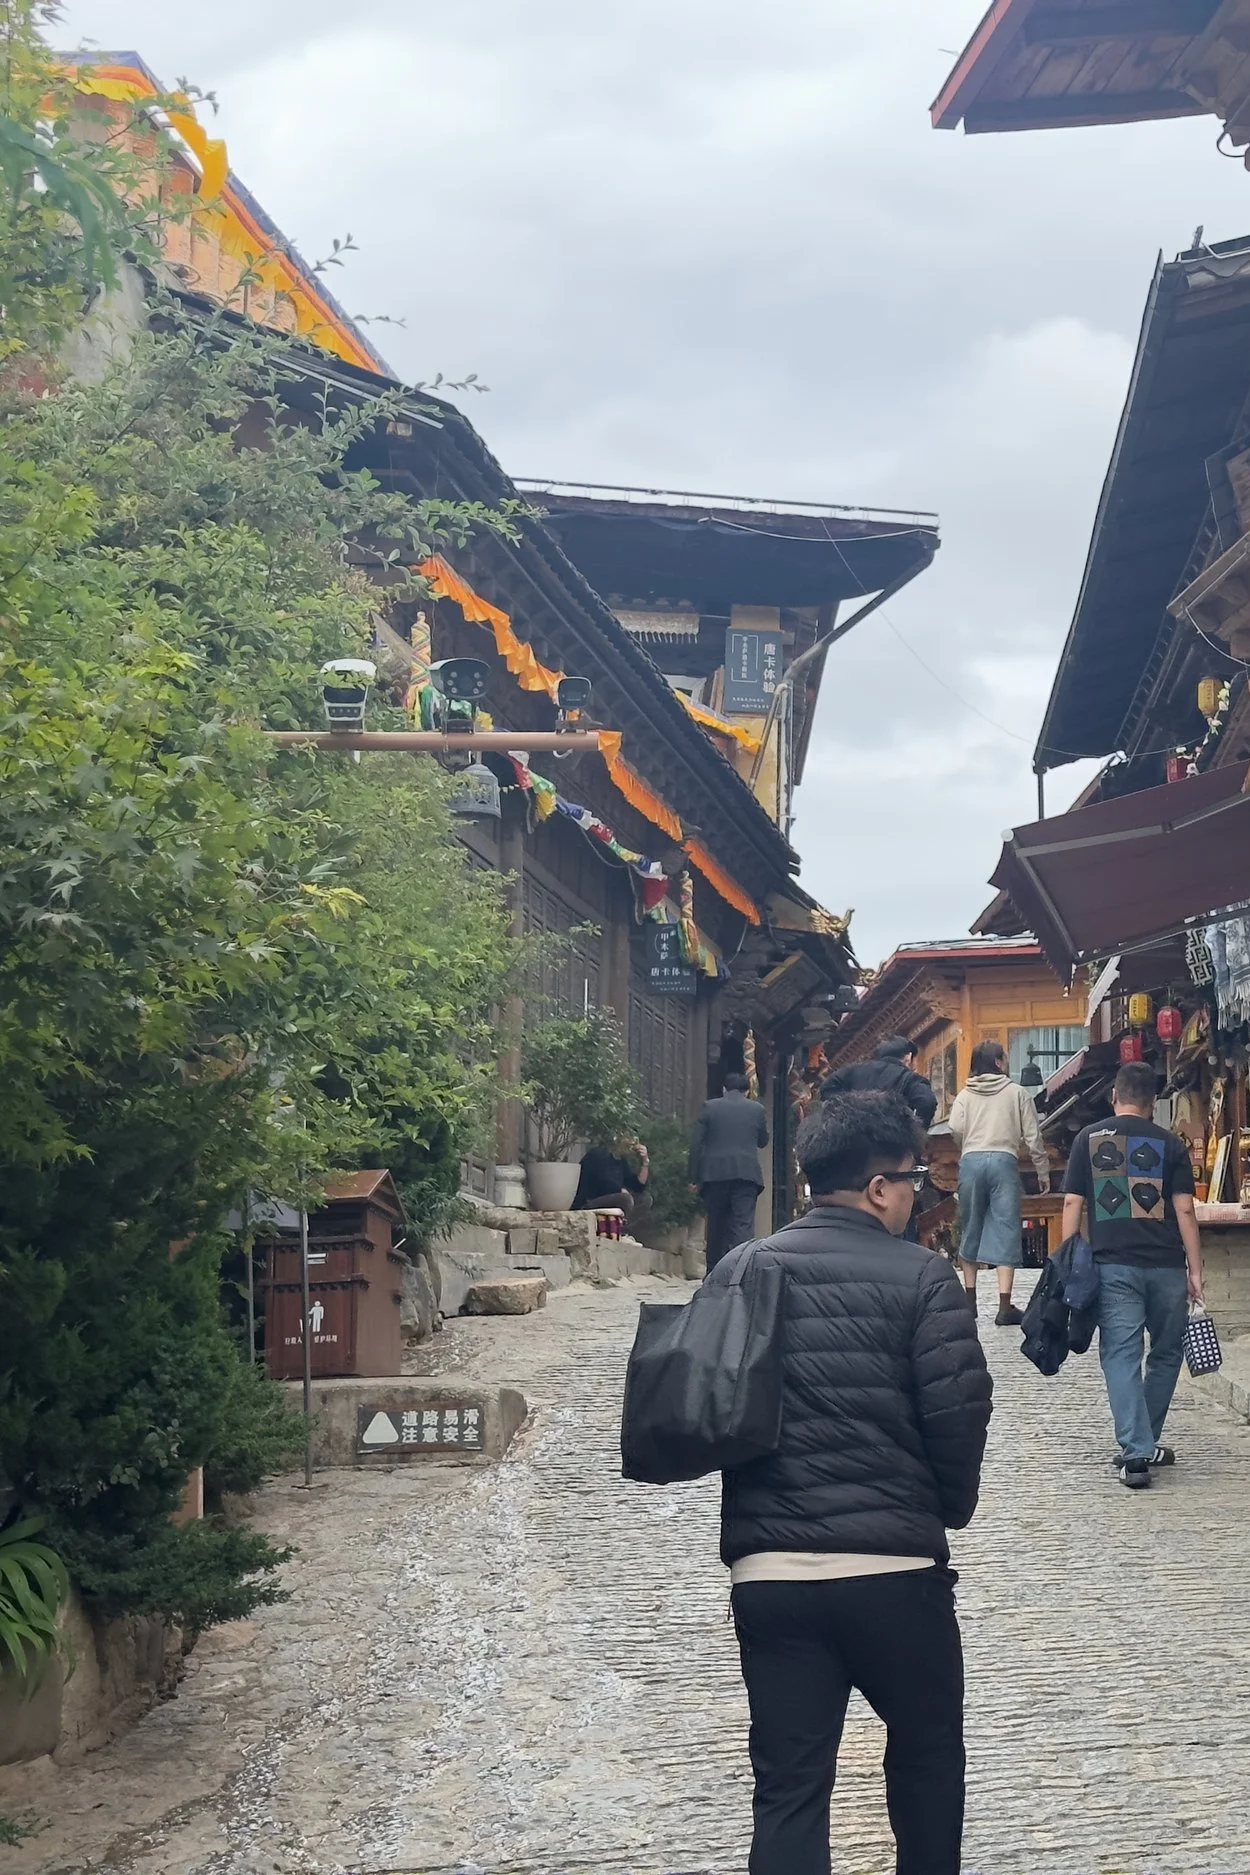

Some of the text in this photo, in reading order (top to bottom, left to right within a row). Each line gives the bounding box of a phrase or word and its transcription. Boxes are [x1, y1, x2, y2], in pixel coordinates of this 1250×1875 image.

[763, 643, 776, 693] 唐卡体验
[402, 1408, 480, 1427] 道路易滑
[402, 1426, 479, 1443] 注意安全
